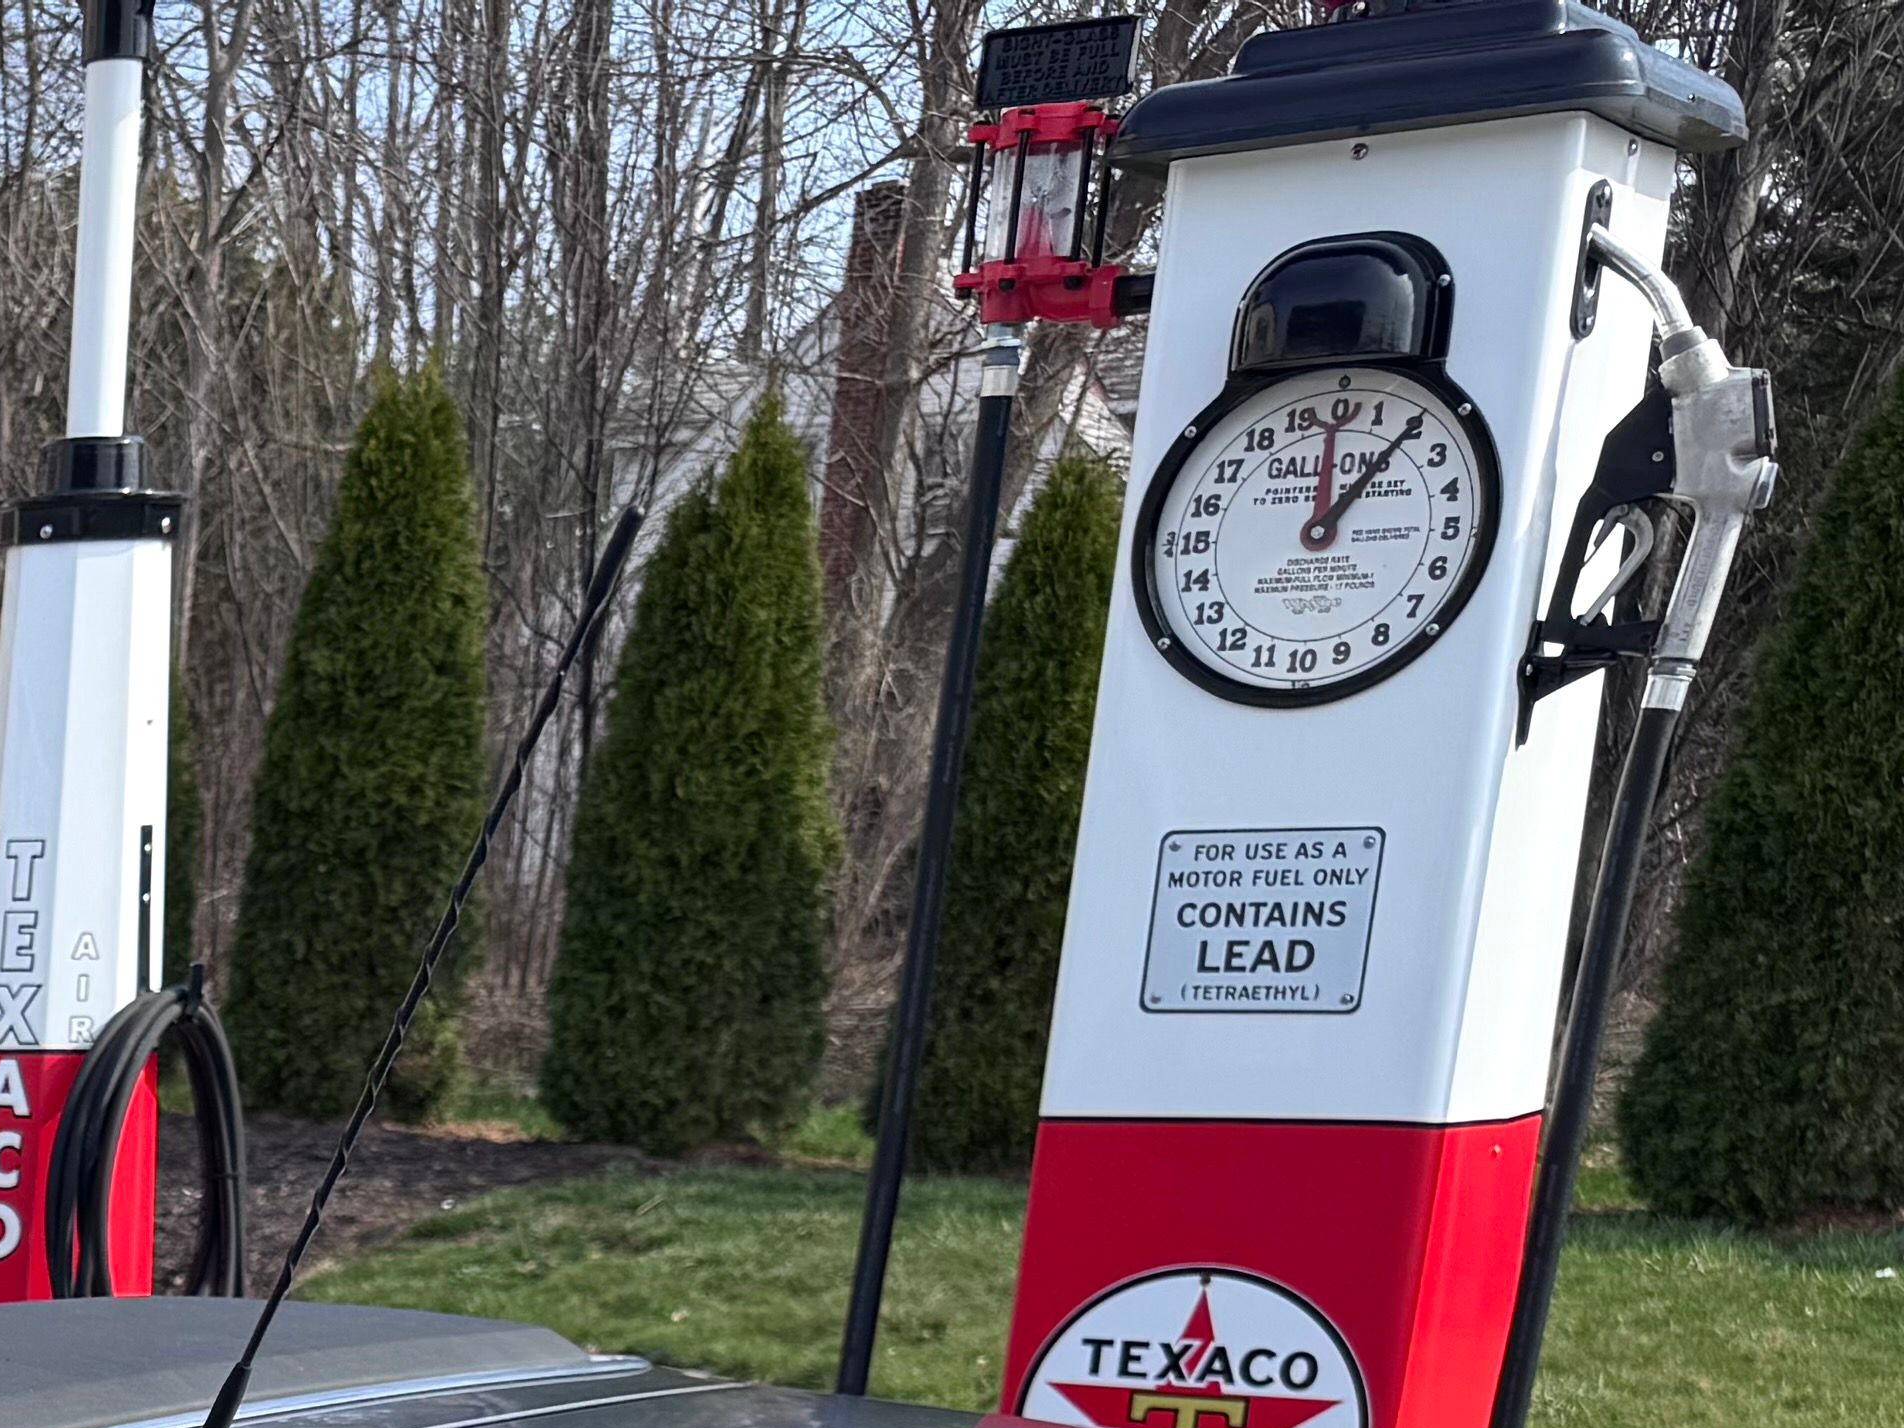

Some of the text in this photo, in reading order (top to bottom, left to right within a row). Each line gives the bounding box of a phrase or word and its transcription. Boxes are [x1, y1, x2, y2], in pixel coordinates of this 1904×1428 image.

[995, 42, 1120, 70] MUST BE FULL
[999, 60, 1110, 86] BEFORE AND
[1284, 407, 1316, 433] 19
[1331, 398, 1350, 422] 0
[1371, 400, 1384, 427] 1
[1243, 427, 1276, 453] 18
[1427, 443, 1448, 468] 3
[1213, 458, 1246, 485] 17
[1440, 477, 1460, 502] 4
[1190, 493, 1222, 518] 16
[1440, 516, 1461, 541] 5
[1179, 530, 1212, 556] 15
[1180, 567, 1210, 593] 14
[1427, 556, 1448, 581] 6
[1193, 601, 1225, 626] 13
[1406, 594, 1425, 619] 7
[1216, 627, 1248, 652] 12
[1371, 622, 1390, 647] 8
[1250, 643, 1276, 668] 11
[1286, 649, 1318, 674] 10
[1332, 641, 1352, 666] 9
[1193, 841, 1348, 862] FOR USE AS A
[1167, 867, 1370, 889] MOTOR FUEL ONLY
[1176, 900, 1348, 928] CONTAINS
[1196, 939, 1315, 974] LEAD
[68, 932, 100, 1044] AIR
[1180, 984, 1320, 1002] (TETRAETHYL)
[1082, 1338, 1318, 1391] TEXACO
